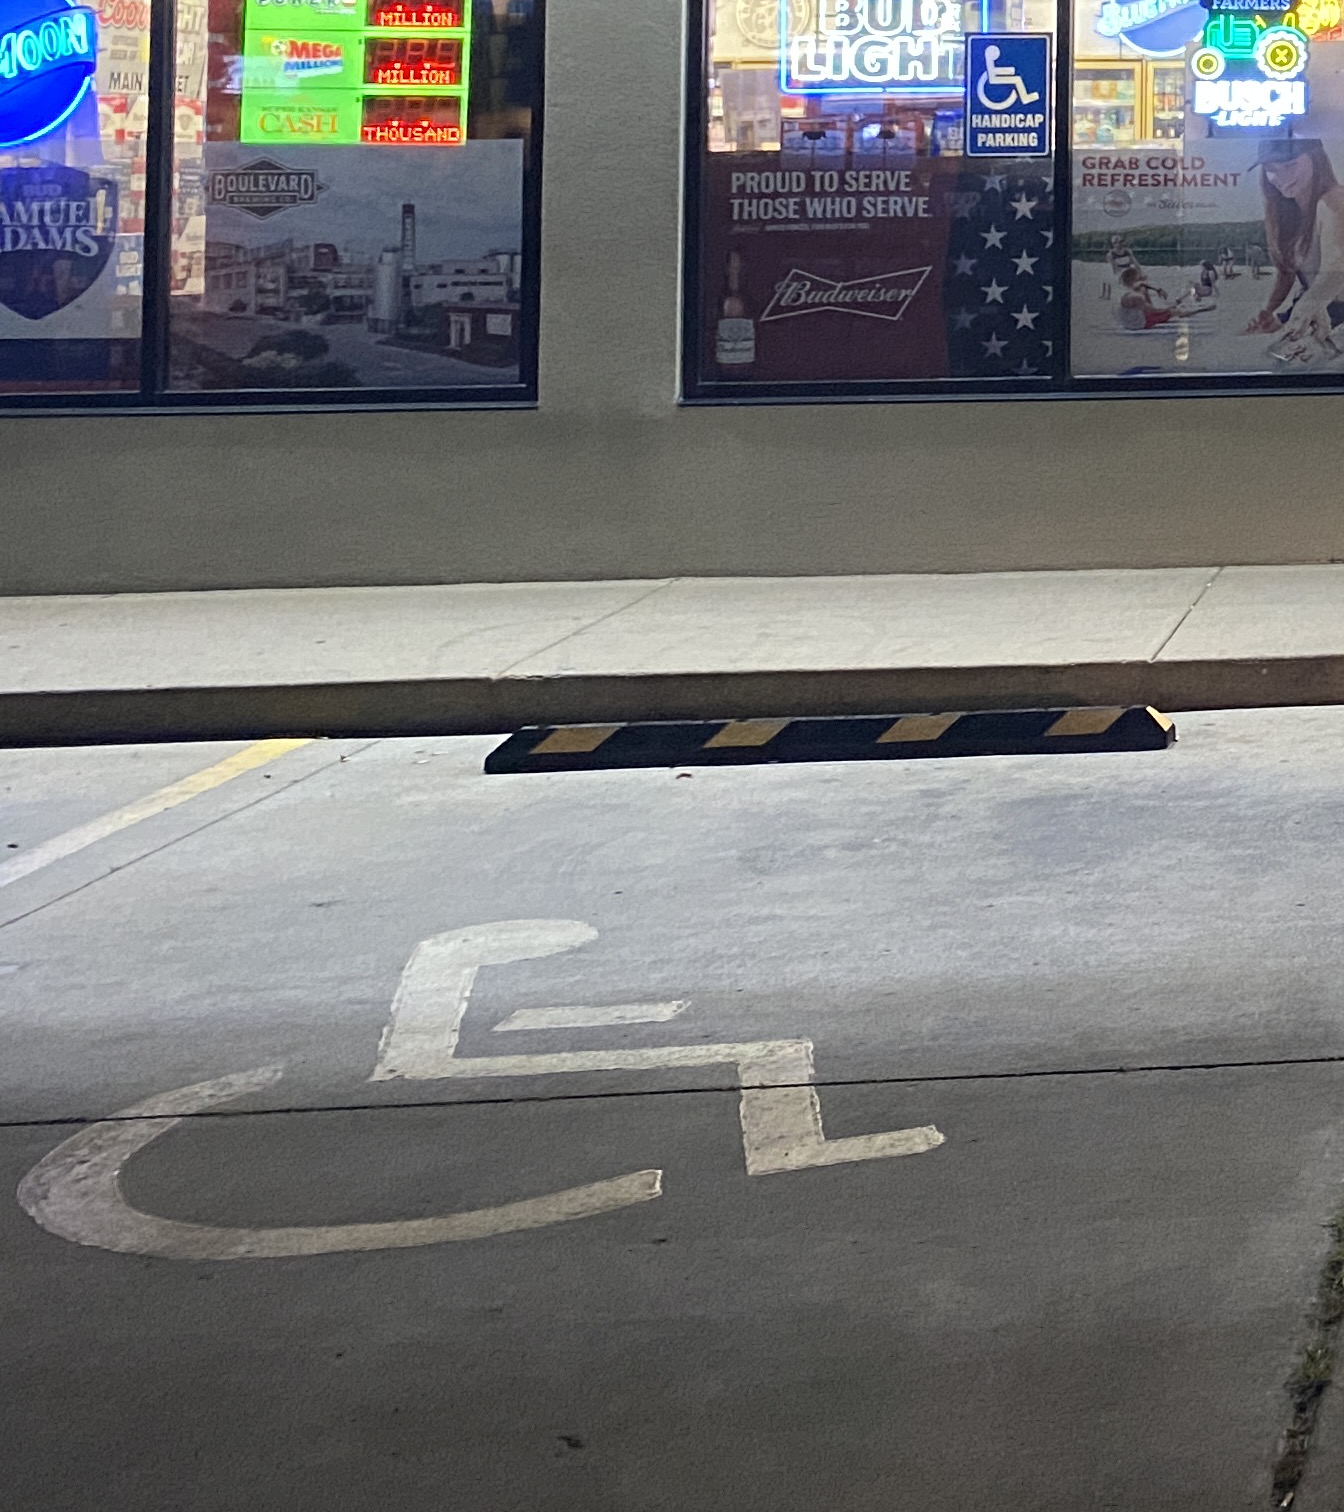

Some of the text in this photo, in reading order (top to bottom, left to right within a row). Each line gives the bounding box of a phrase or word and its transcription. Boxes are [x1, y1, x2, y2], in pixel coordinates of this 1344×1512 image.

[380, 10, 454, 27] MILLION
[287, 40, 342, 59] MEGA
[790, 37, 966, 83] LIGHT
[109, 71, 144, 93] MAIN
[377, 68, 451, 84] MILLION
[1194, 80, 1306, 115] BUSCH
[258, 112, 339, 134] CASH
[971, 113, 1045, 129] HANDICAP
[362, 126, 461, 143] THOUSAND
[977, 133, 1039, 148] PARKING
[1082, 156, 1206, 170] GRAB COLD
[213, 174, 313, 200] BOULEVARD
[730, 171, 912, 194] PROUD TO SERVE
[1081, 172, 1242, 188] REFRESHMENT
[730, 198, 800, 221] THOSE
[805, 197, 856, 219] WHO
[0, 226, 99, 257] DAMS
[773, 281, 914, 307] Budweiser
